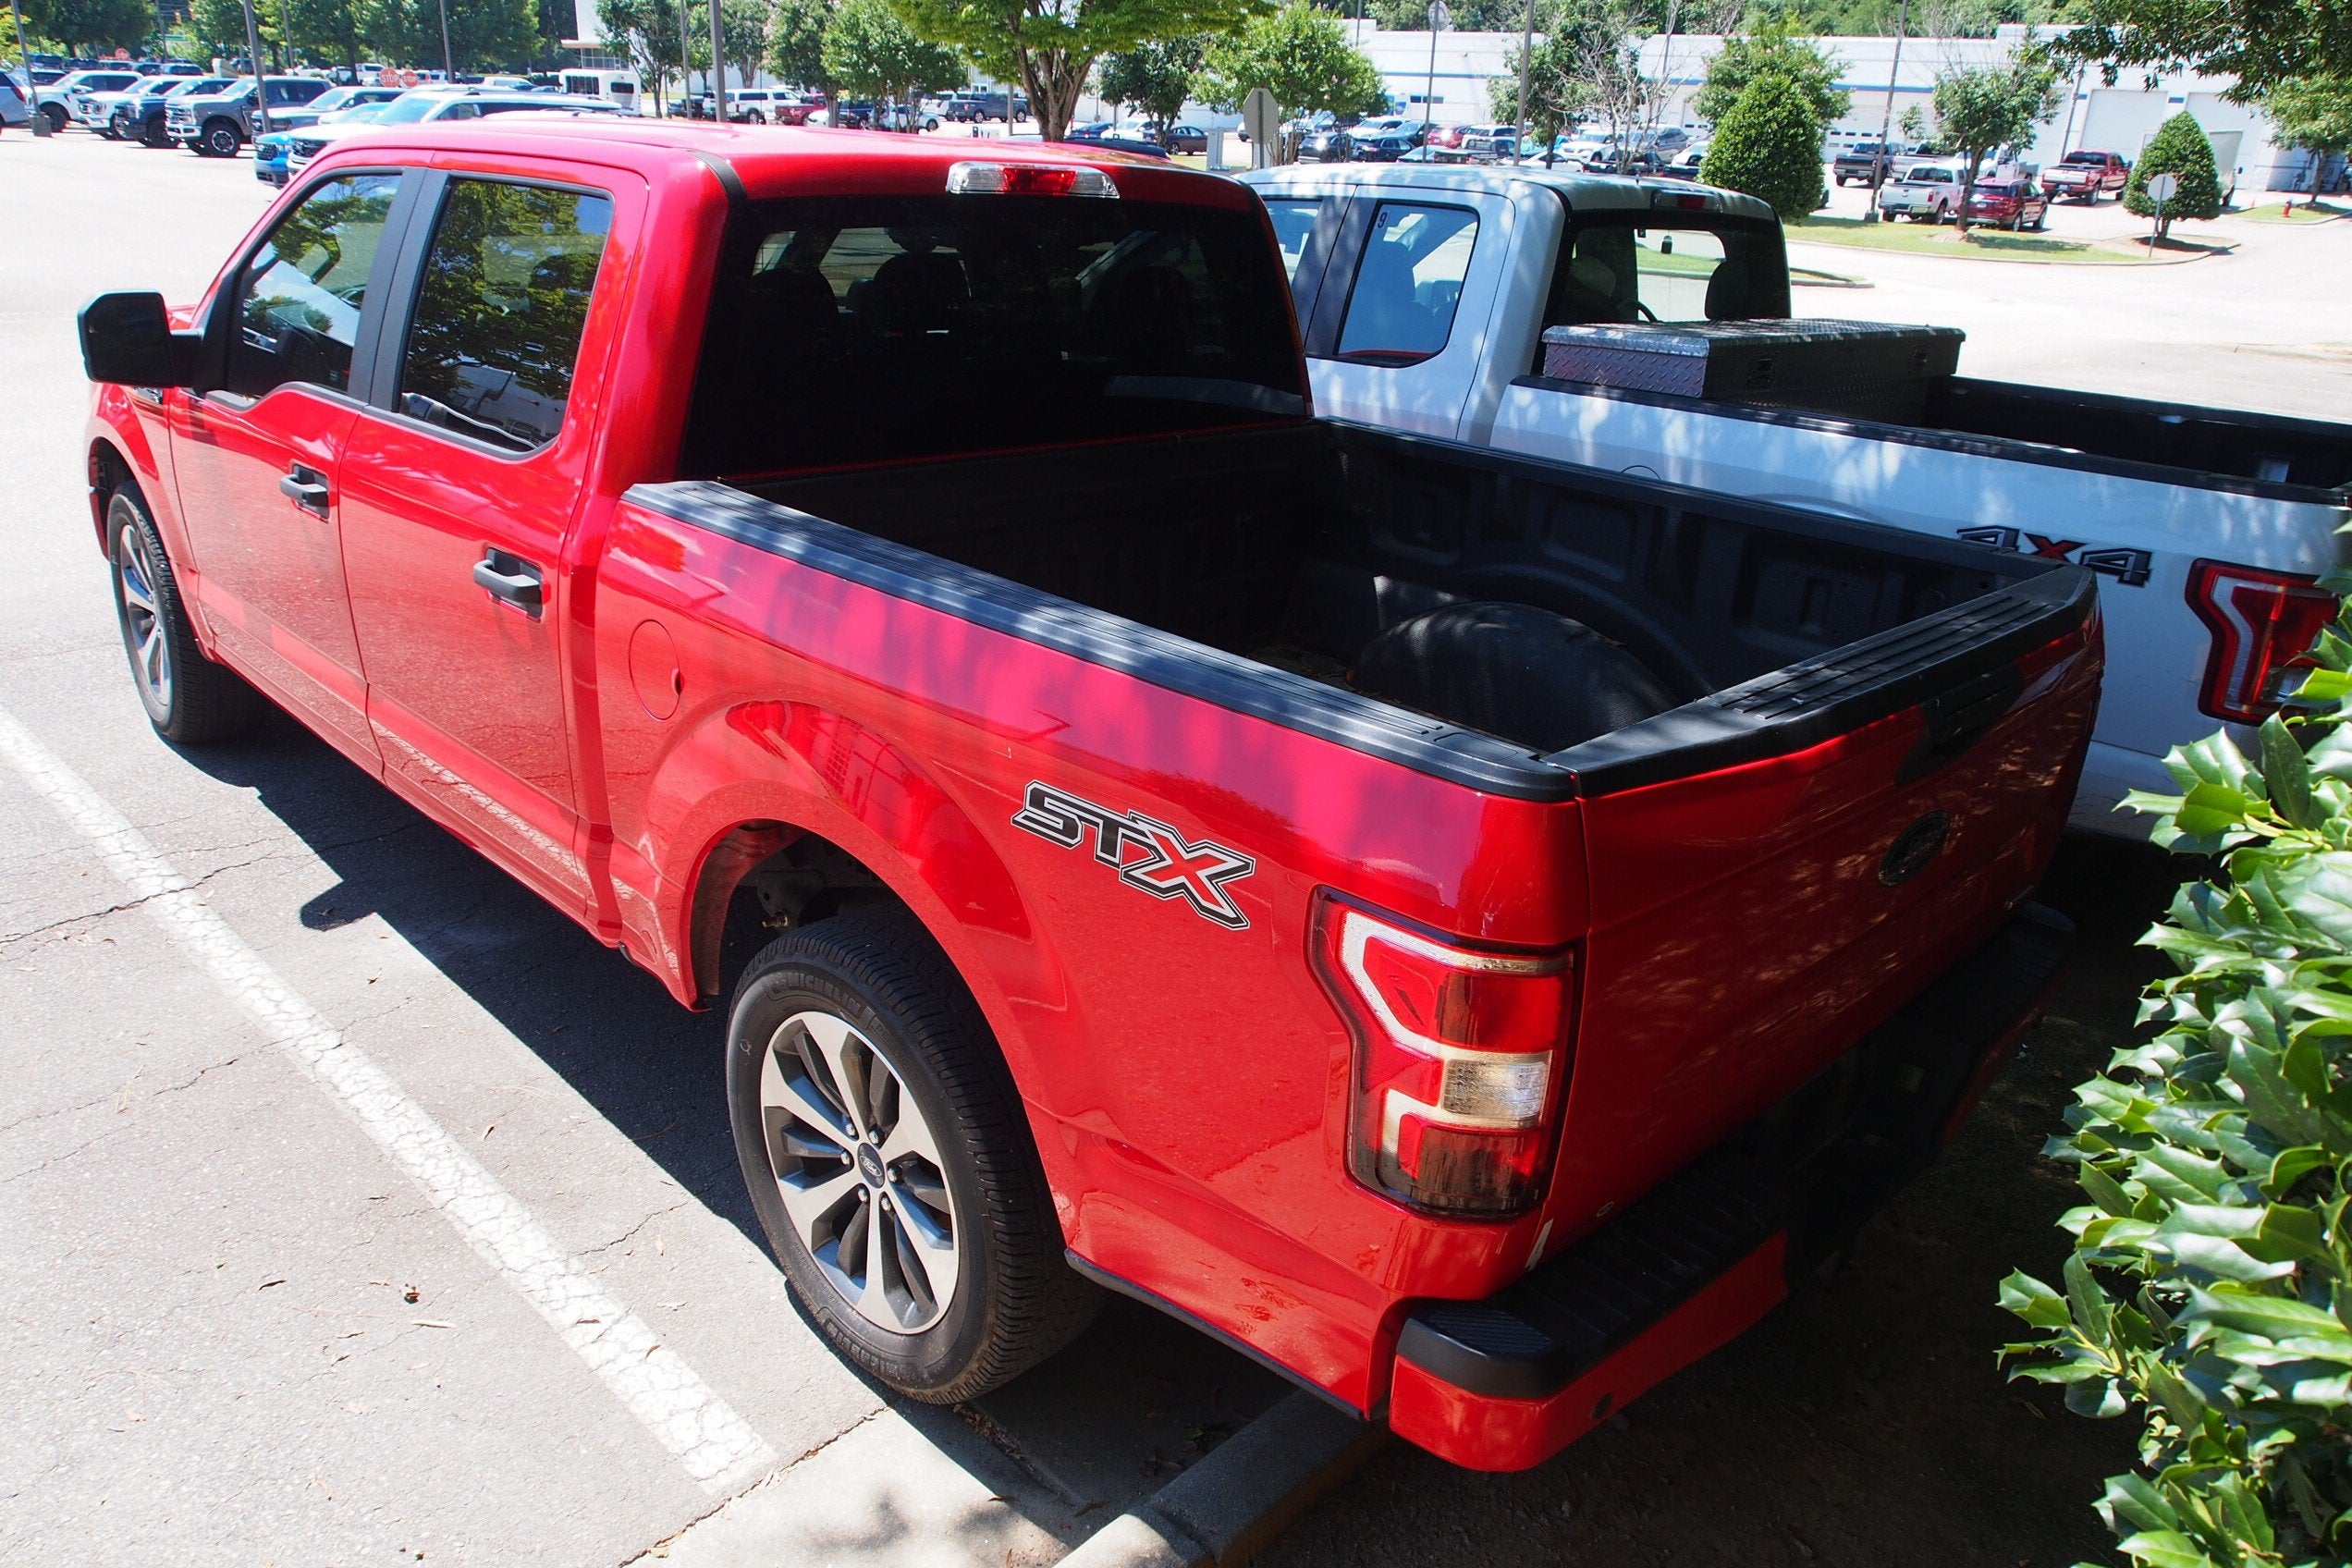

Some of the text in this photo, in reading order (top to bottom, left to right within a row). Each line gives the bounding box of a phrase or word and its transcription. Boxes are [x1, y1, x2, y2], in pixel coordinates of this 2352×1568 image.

[382, 74, 398, 83] STOP
[403, 75, 417, 83] STOP
[1378, 212, 1388, 228] 9
[1011, 779, 1256, 931] STX
[788, 972, 862, 1015] MICHELIN
